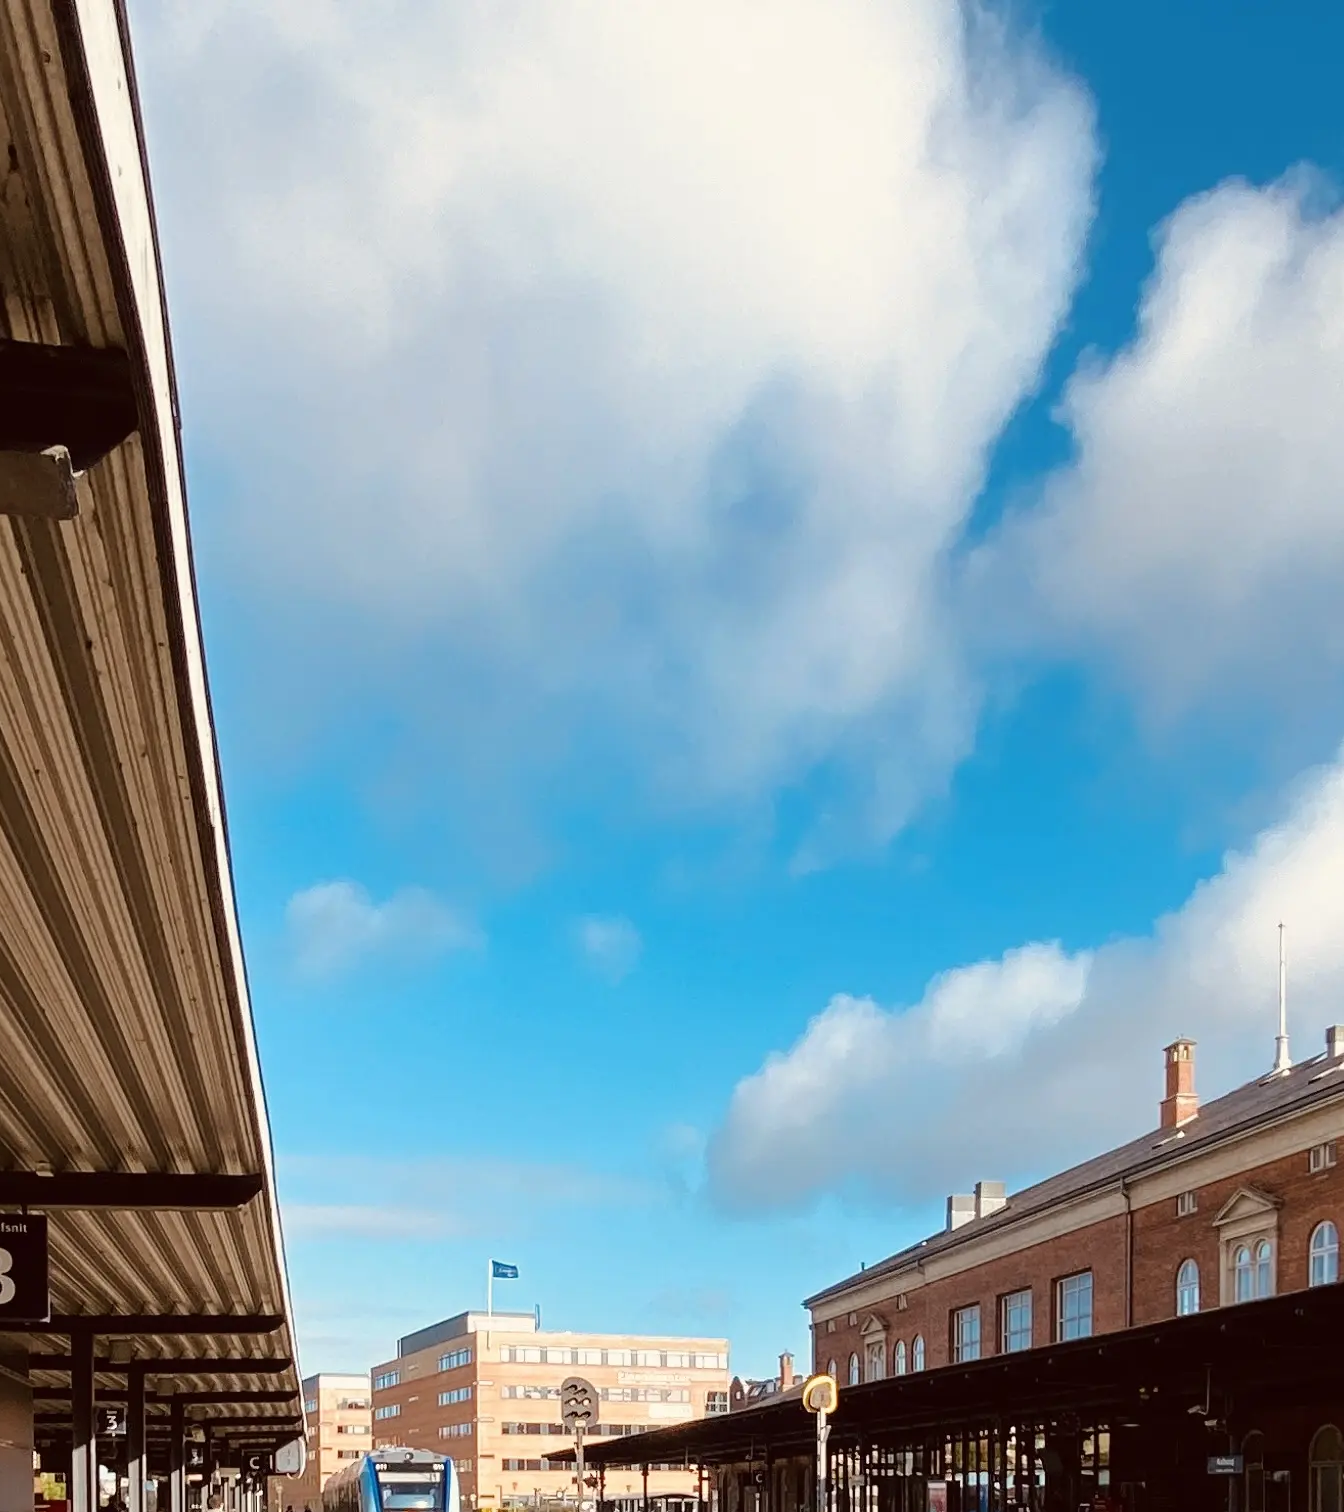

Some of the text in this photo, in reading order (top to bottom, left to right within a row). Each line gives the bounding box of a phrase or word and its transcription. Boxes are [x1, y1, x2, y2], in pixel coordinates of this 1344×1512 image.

[106, 1415, 118, 1430] 3
[249, 1456, 260, 1470] C
[755, 1473, 763, 1483] C
